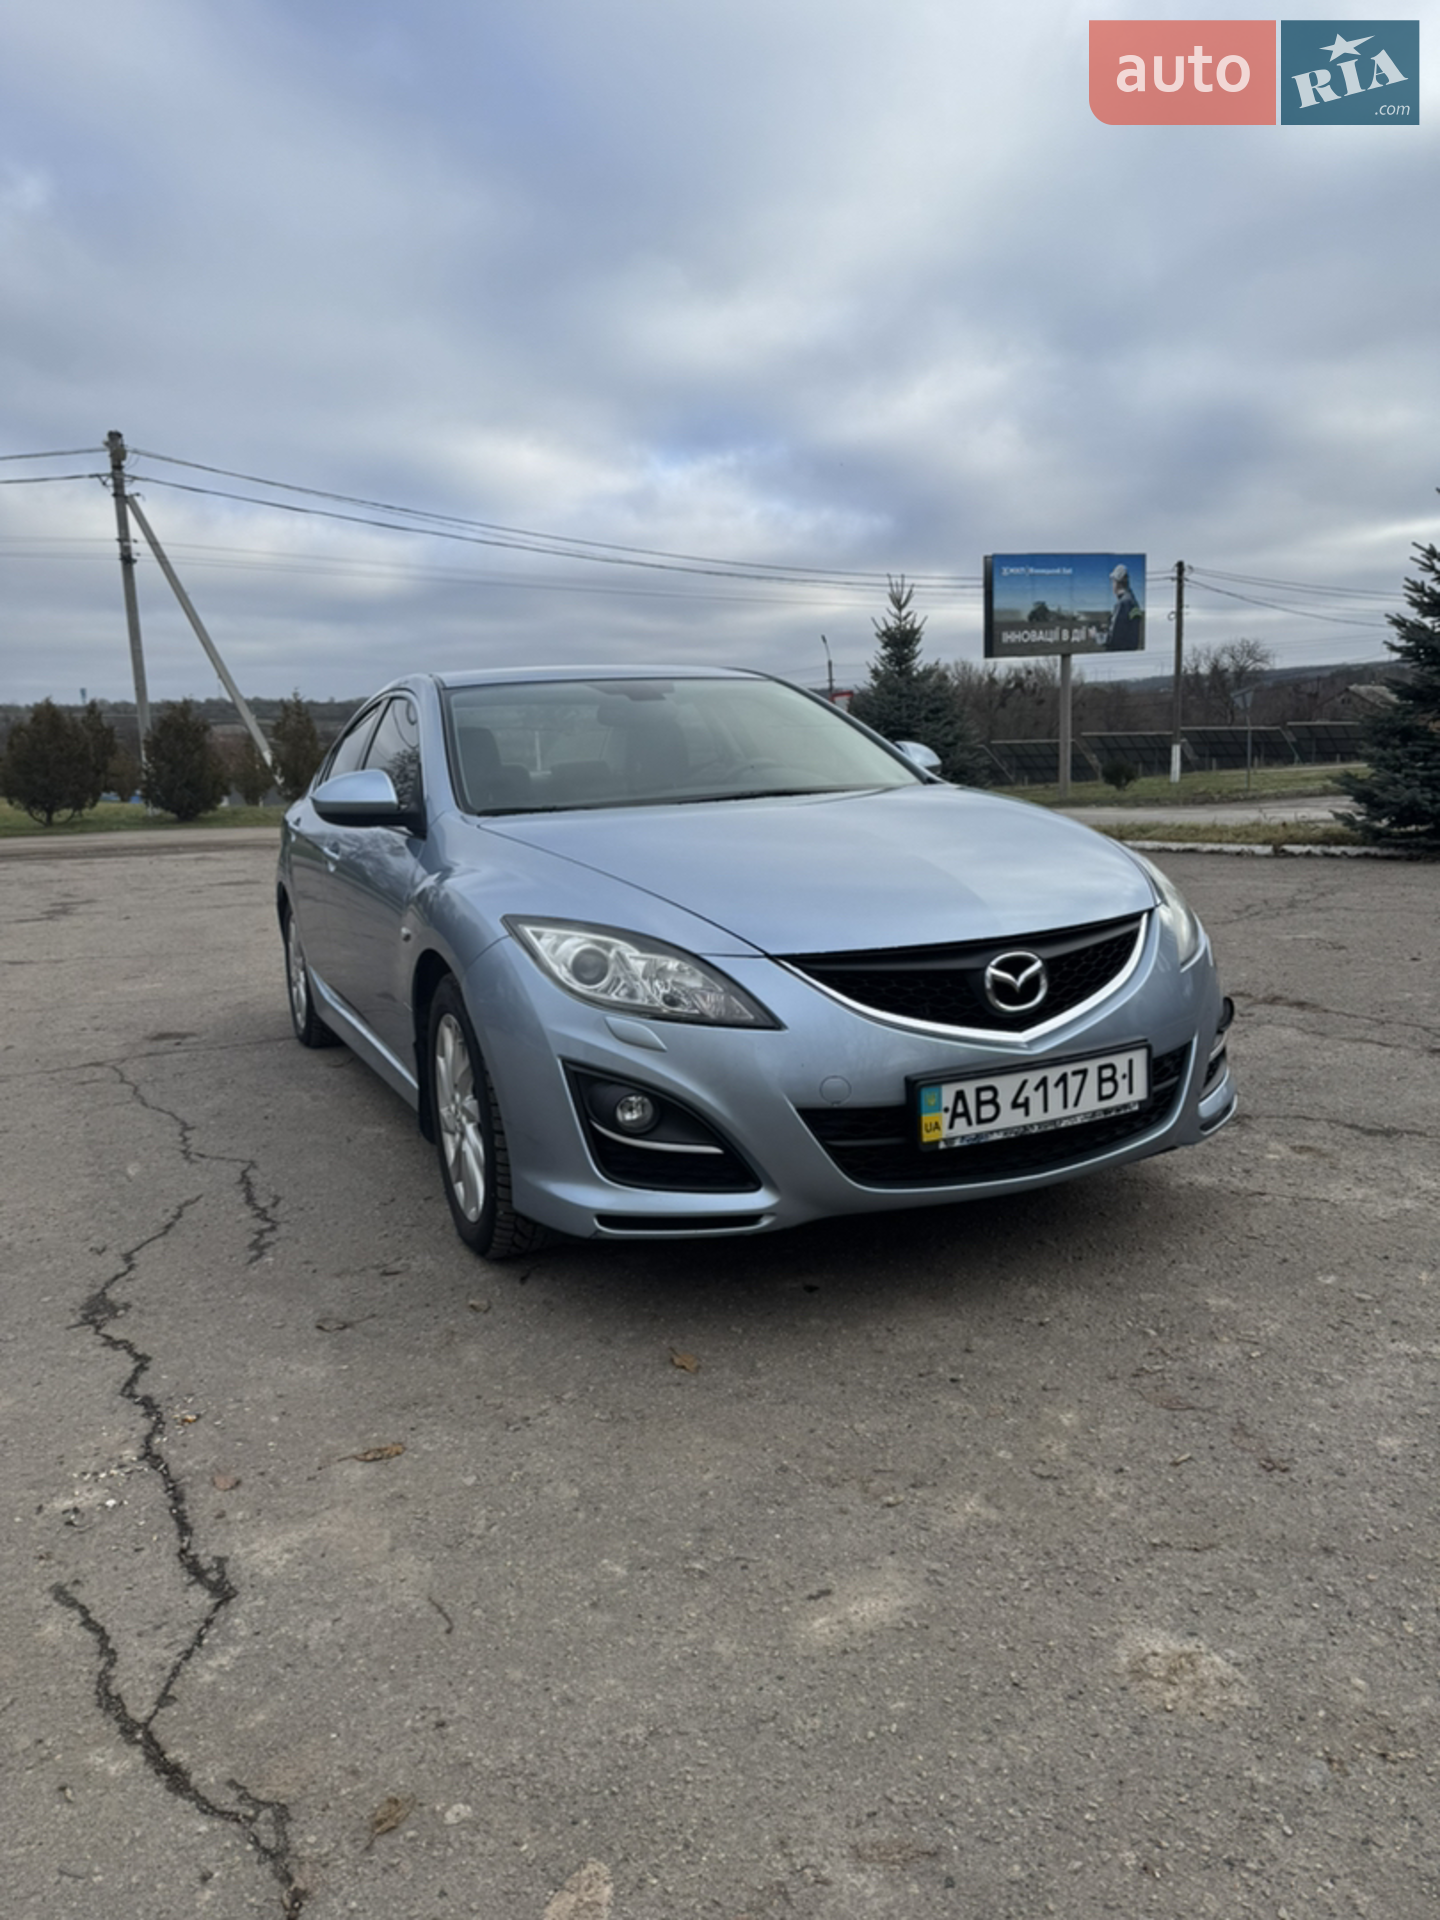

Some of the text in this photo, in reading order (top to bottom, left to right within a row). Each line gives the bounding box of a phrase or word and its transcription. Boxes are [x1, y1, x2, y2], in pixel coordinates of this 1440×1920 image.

[1002, 626, 1060, 643] ІННОВАЦІЇ
[1061, 628, 1069, 642] В
[947, 1085, 1001, 1130] AB
[1011, 1067, 1089, 1117] 4117
[1097, 1058, 1134, 1102] BI
[924, 1121, 941, 1134] UA
